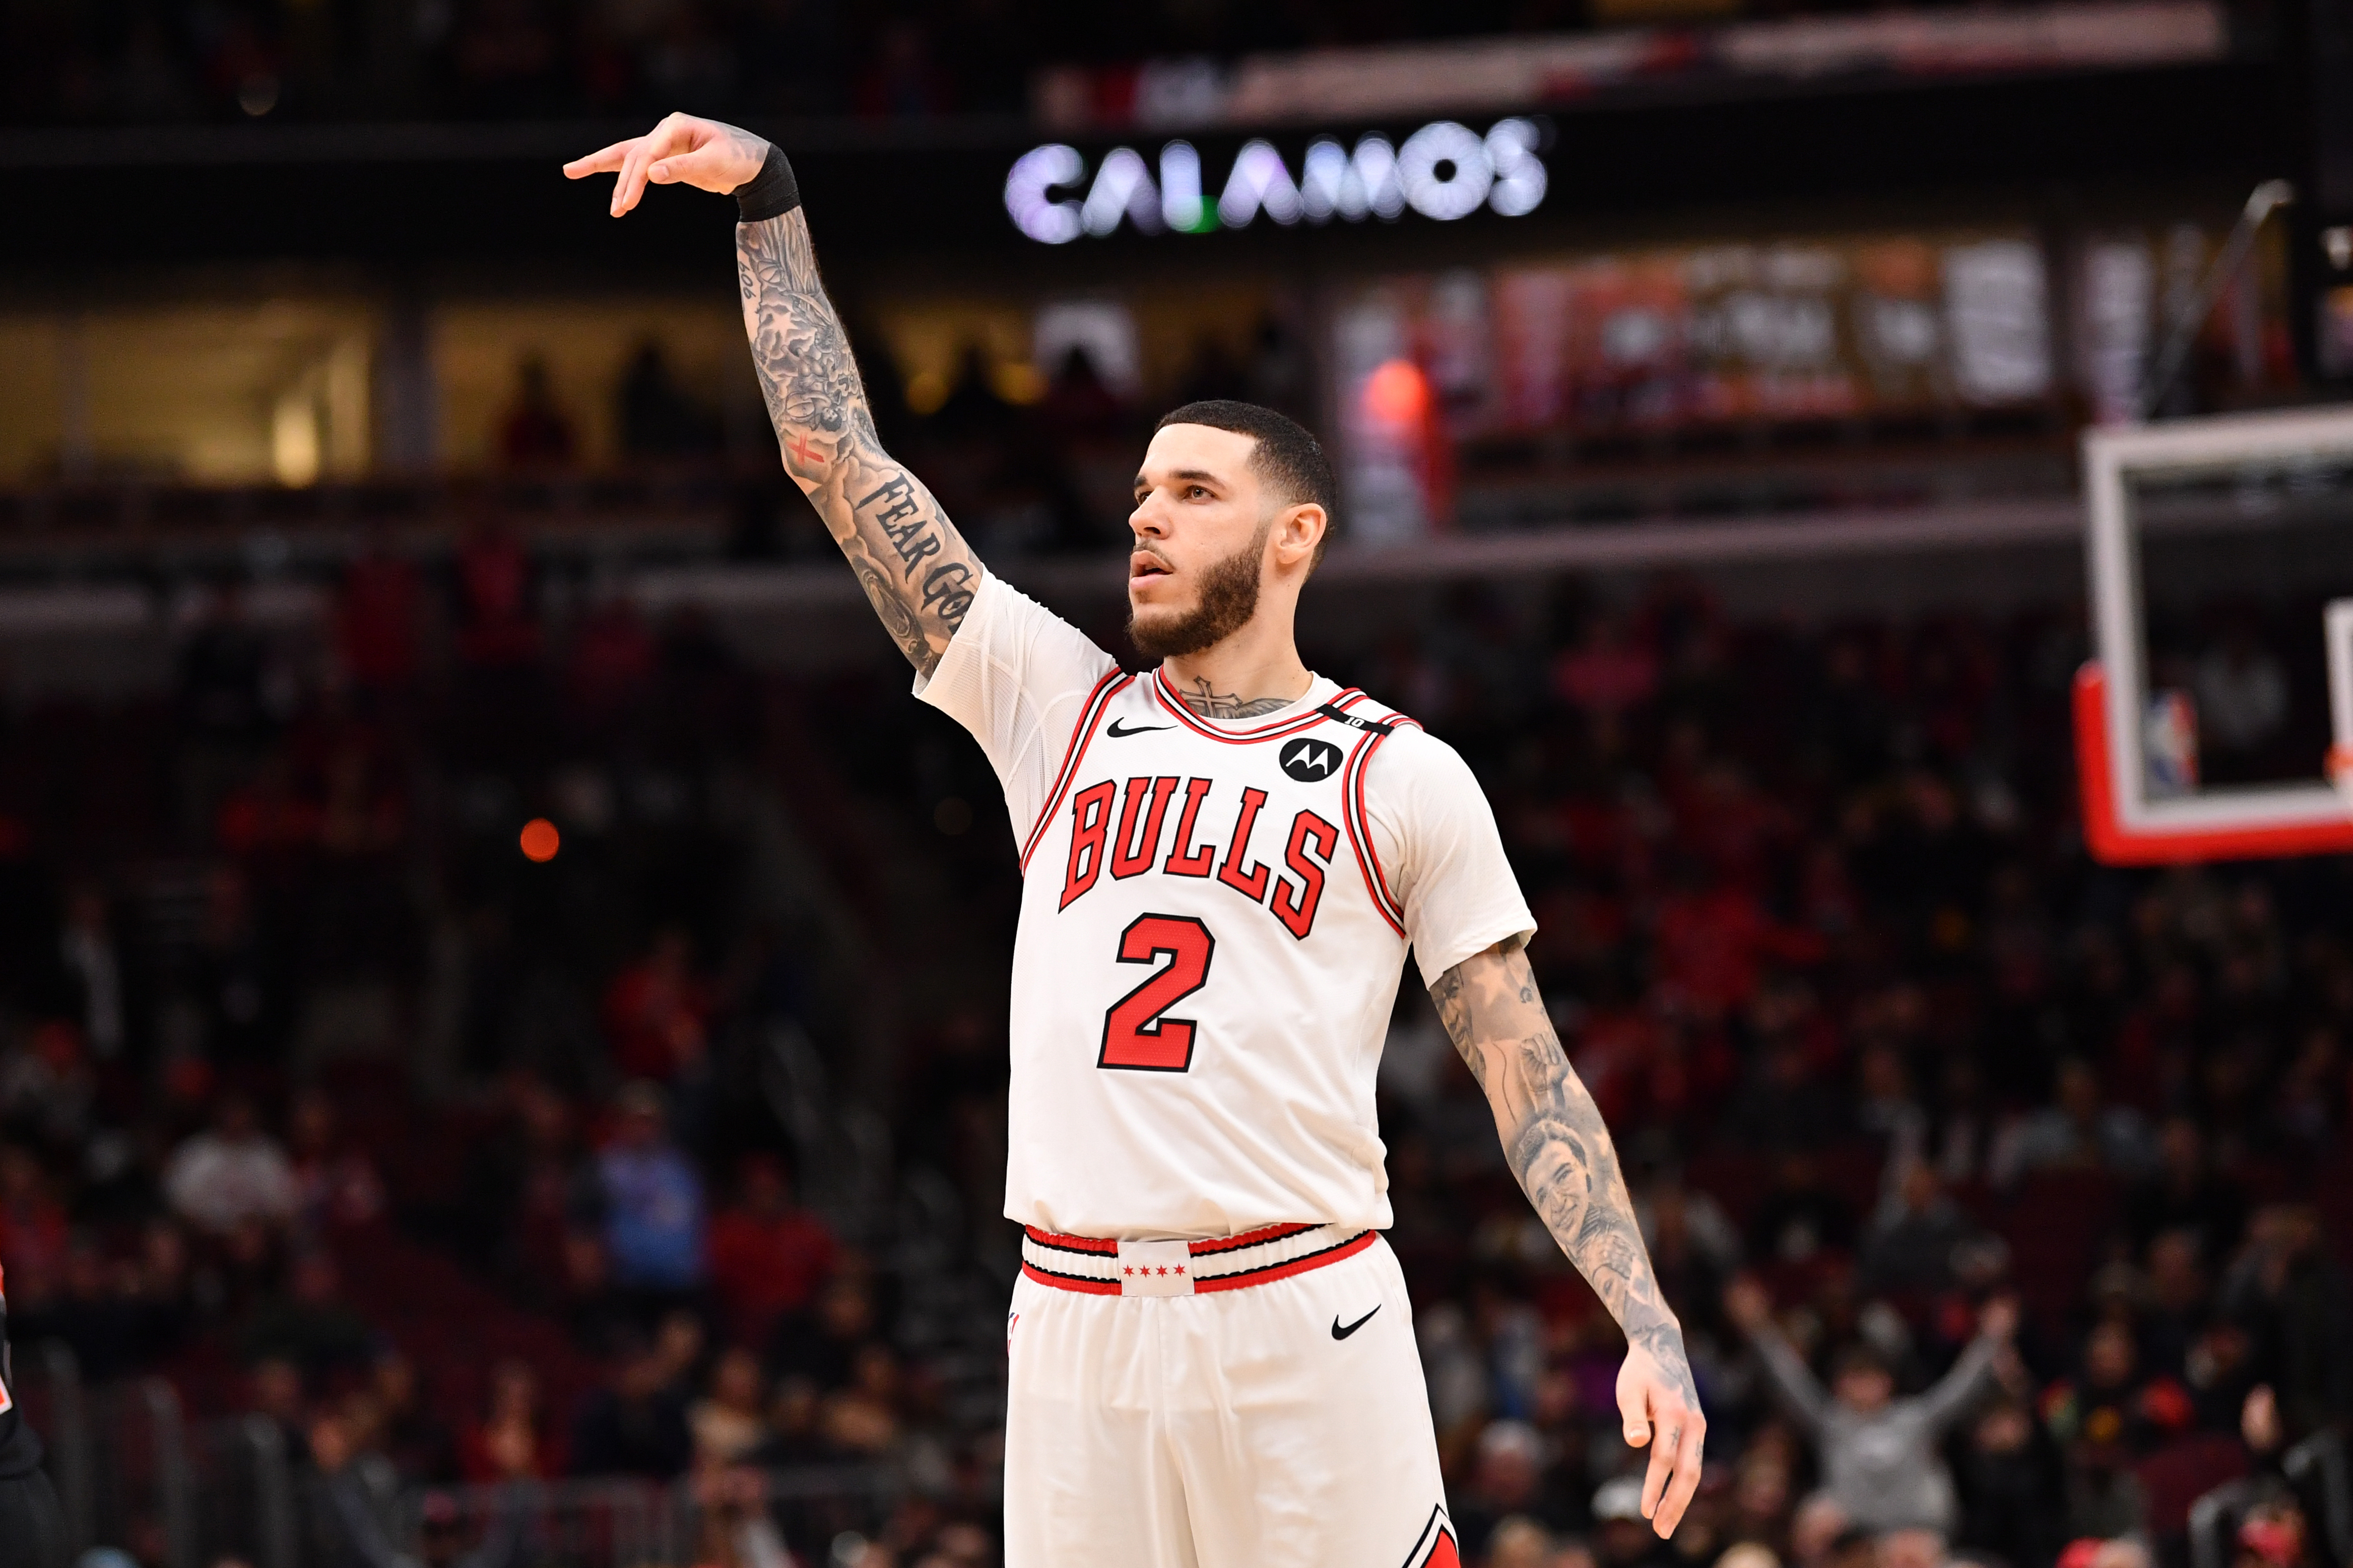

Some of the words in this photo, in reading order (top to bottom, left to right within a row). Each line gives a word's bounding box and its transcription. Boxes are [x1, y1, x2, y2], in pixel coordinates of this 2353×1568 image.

[1003, 117, 1547, 244] CALAMOS
[855, 472, 941, 584] FEAR
[1344, 716, 1365, 728] 10
[1058, 776, 1340, 940] BULLS
[1097, 912, 1215, 1072] 2
